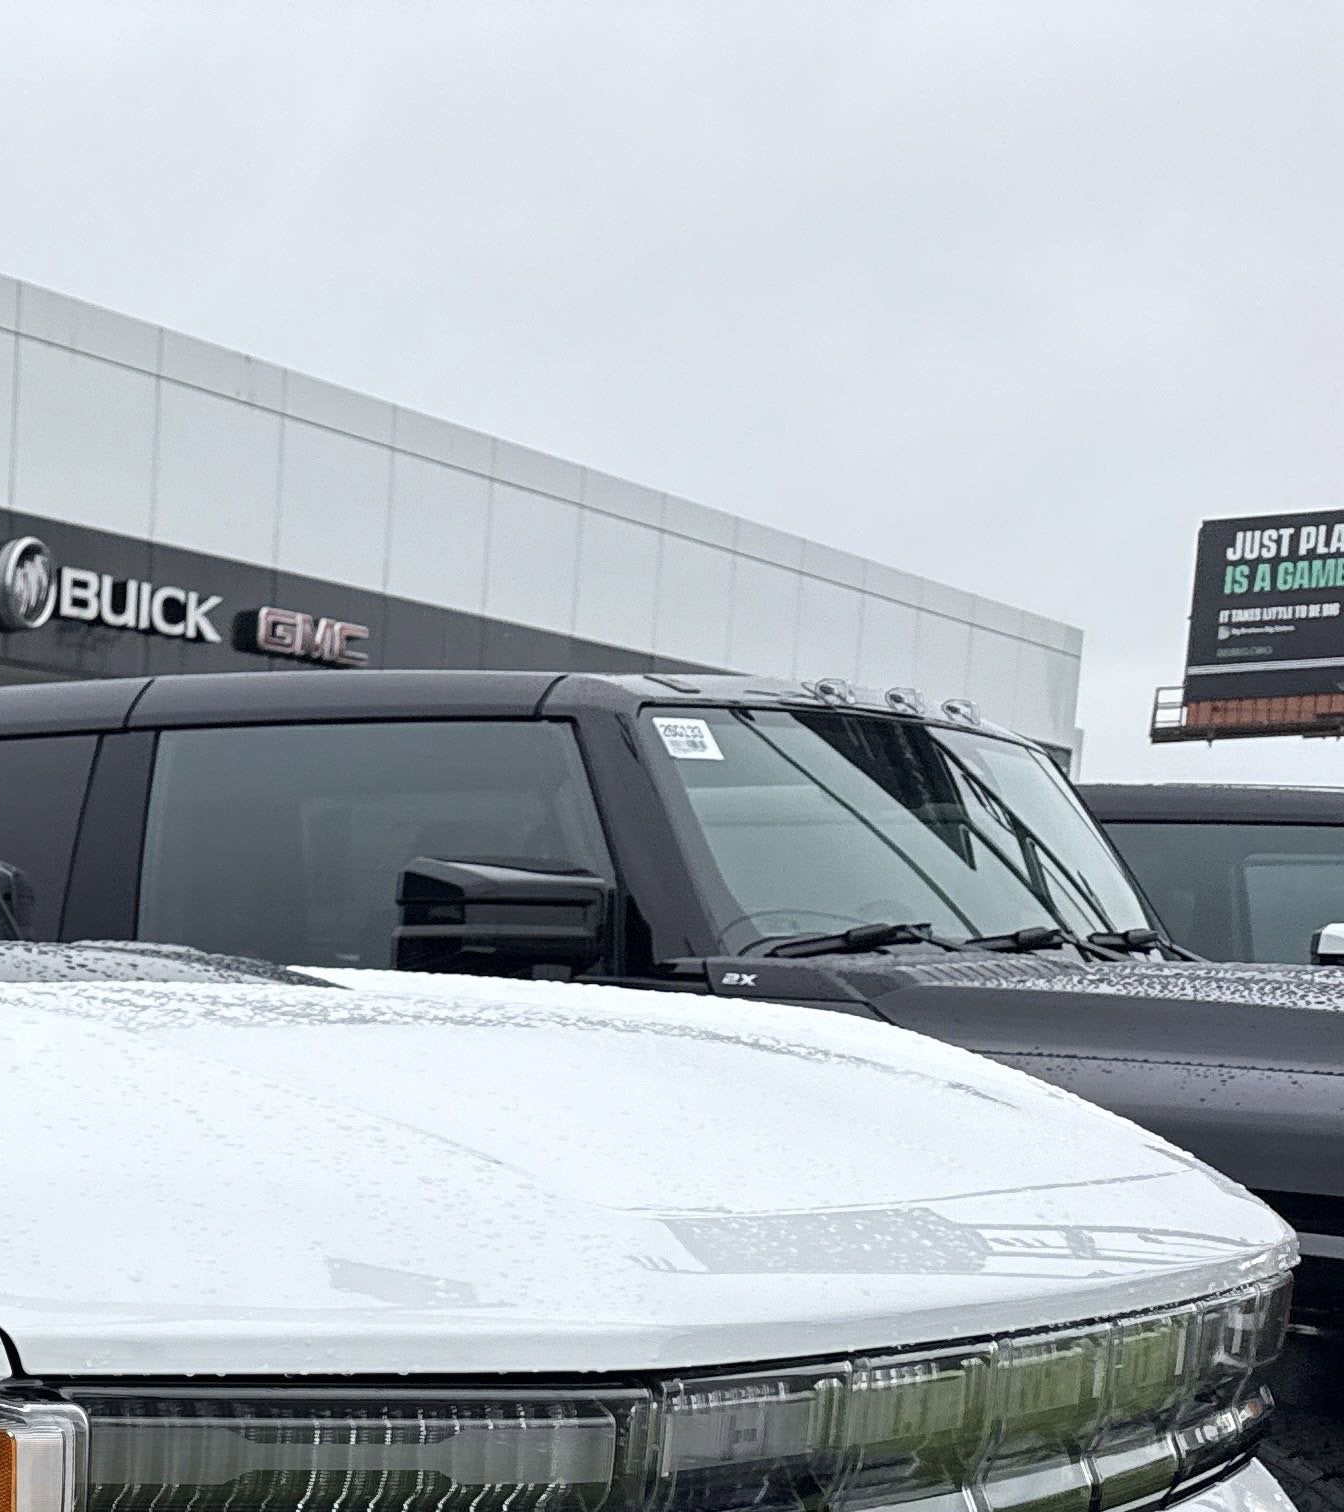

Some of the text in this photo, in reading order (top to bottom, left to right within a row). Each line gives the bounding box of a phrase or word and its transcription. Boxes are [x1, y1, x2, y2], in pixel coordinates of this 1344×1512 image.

[1226, 528, 1295, 561] JUST
[1224, 565, 1250, 594] IS
[1253, 563, 1272, 592] A
[60, 566, 223, 643] BUICK
[257, 606, 369, 667] GMC
